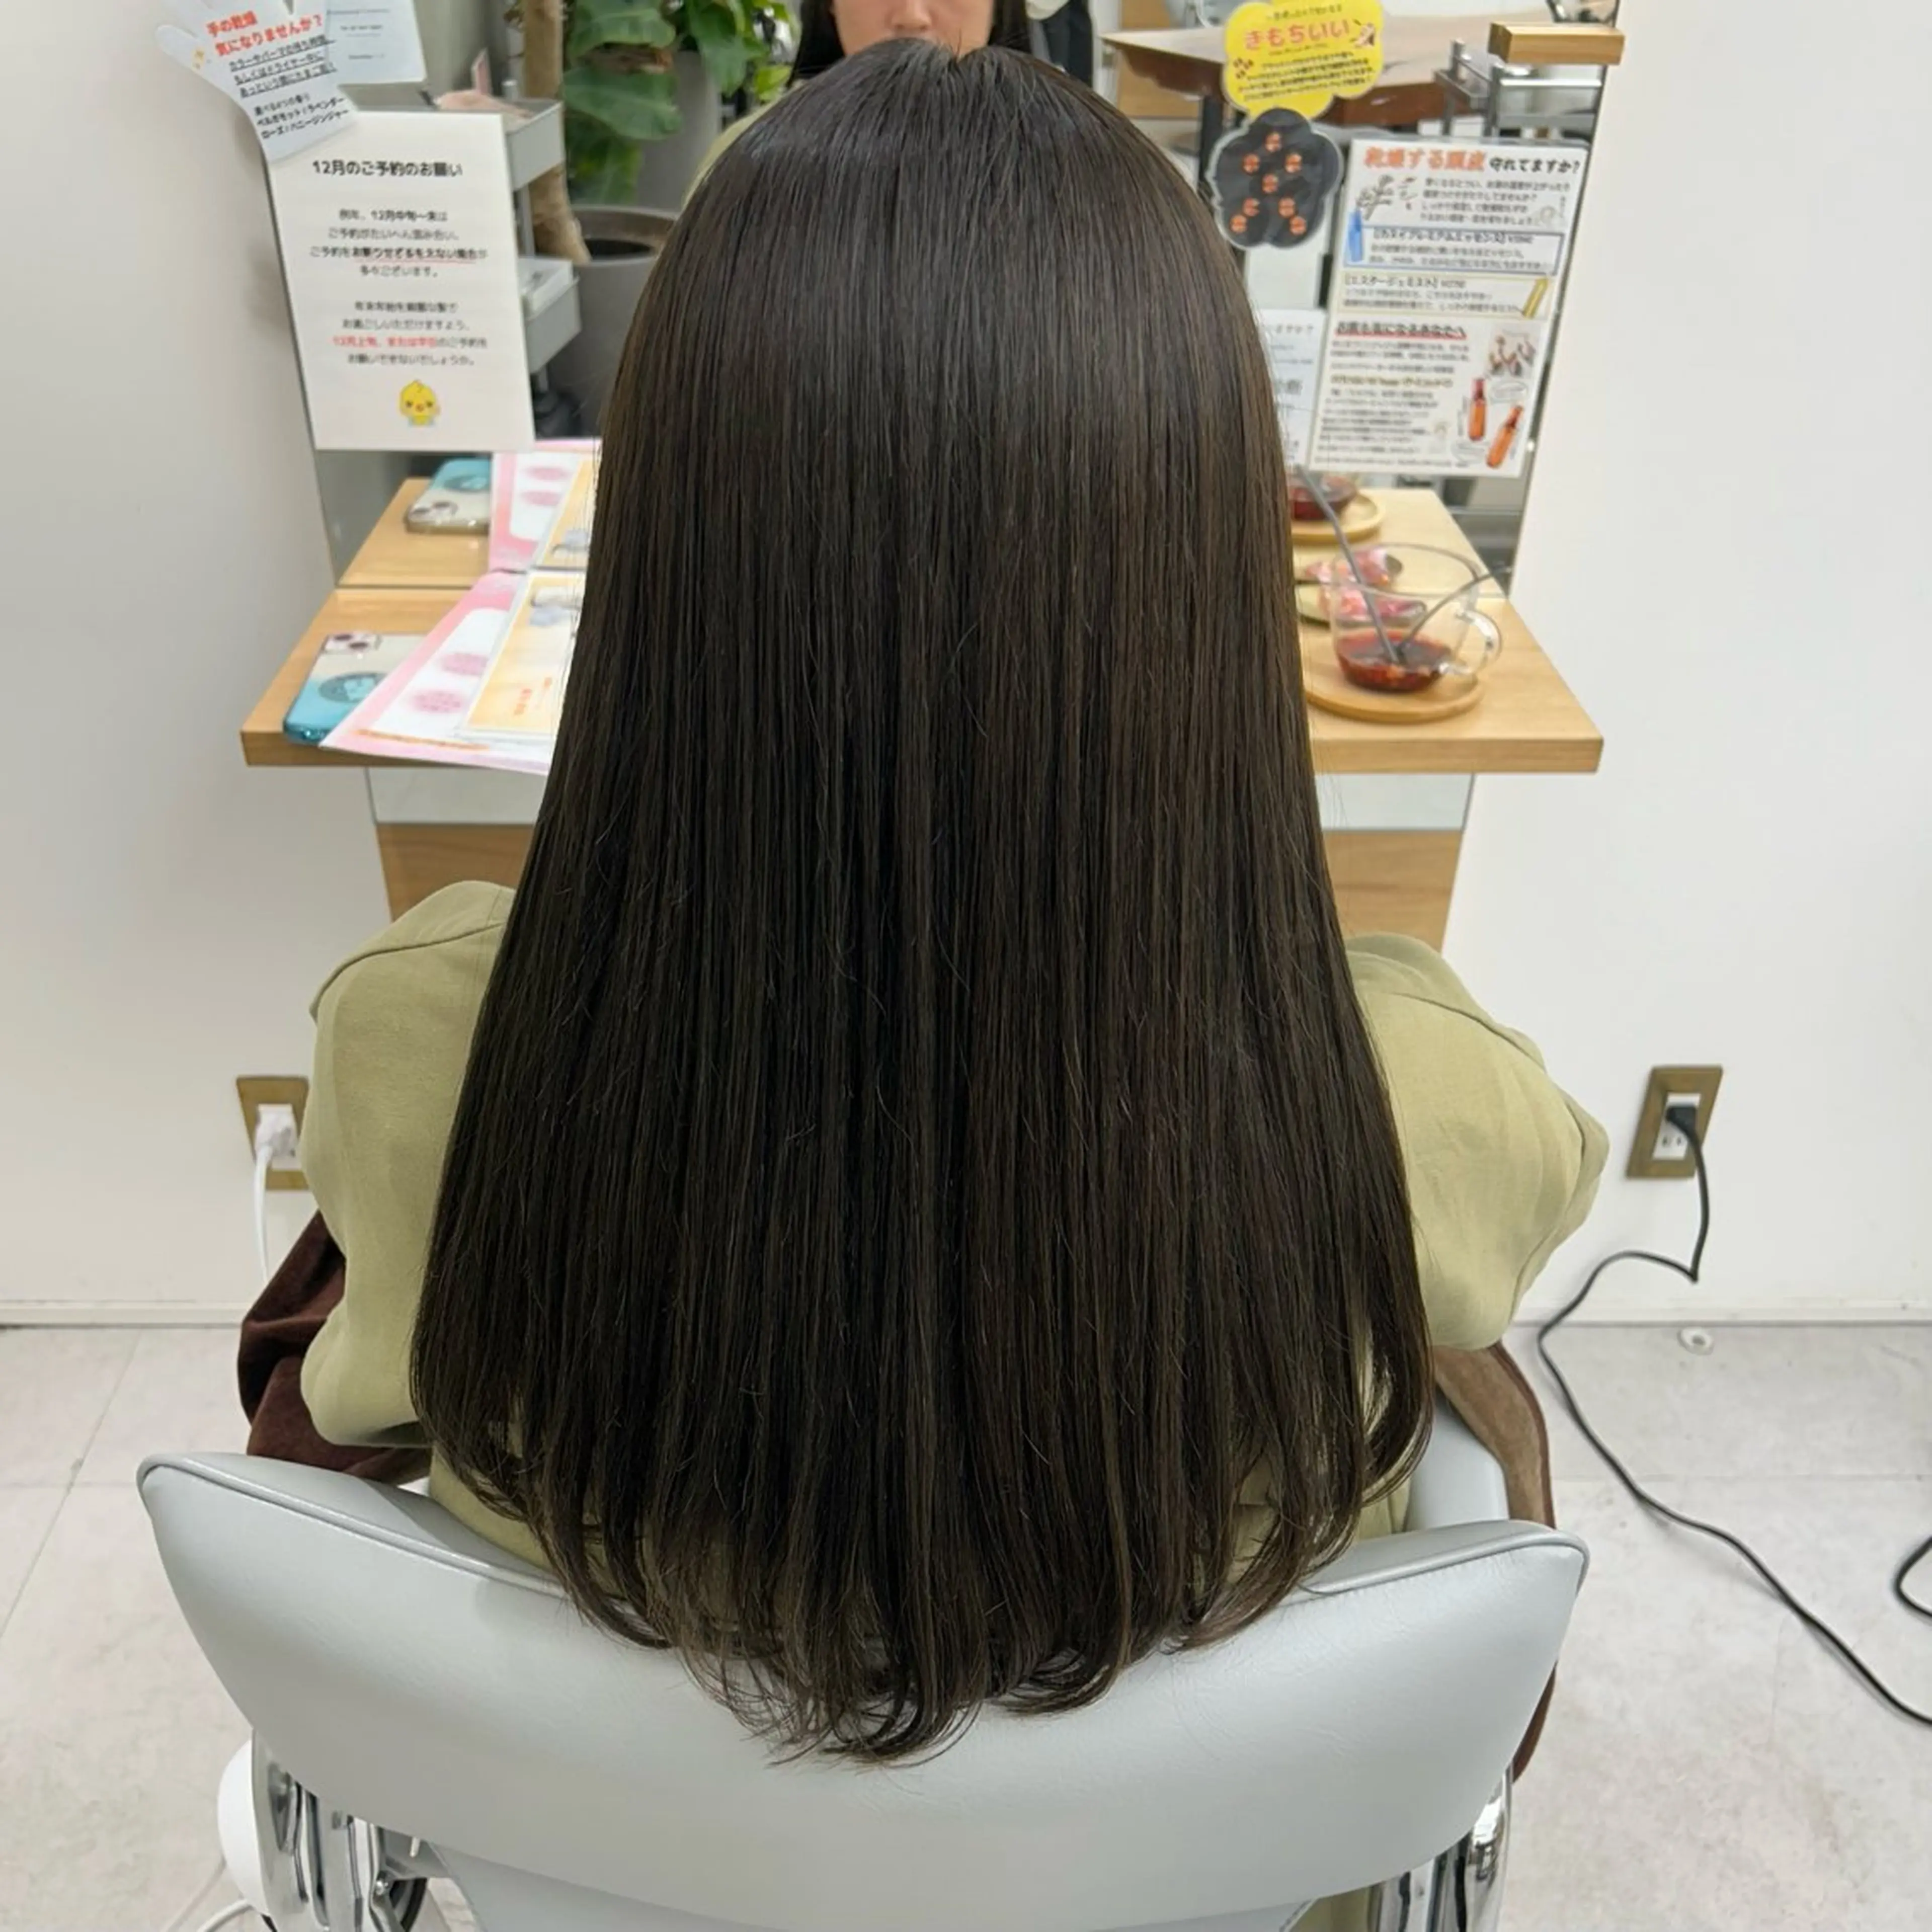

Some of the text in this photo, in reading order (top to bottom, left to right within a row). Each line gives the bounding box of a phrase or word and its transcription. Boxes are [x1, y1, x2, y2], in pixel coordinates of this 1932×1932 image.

[215, 14, 323, 56] 気になりませんか?
[1244, 19, 1350, 51] きもちいい
[312, 159, 463, 176] 12月のご予約のお願い
